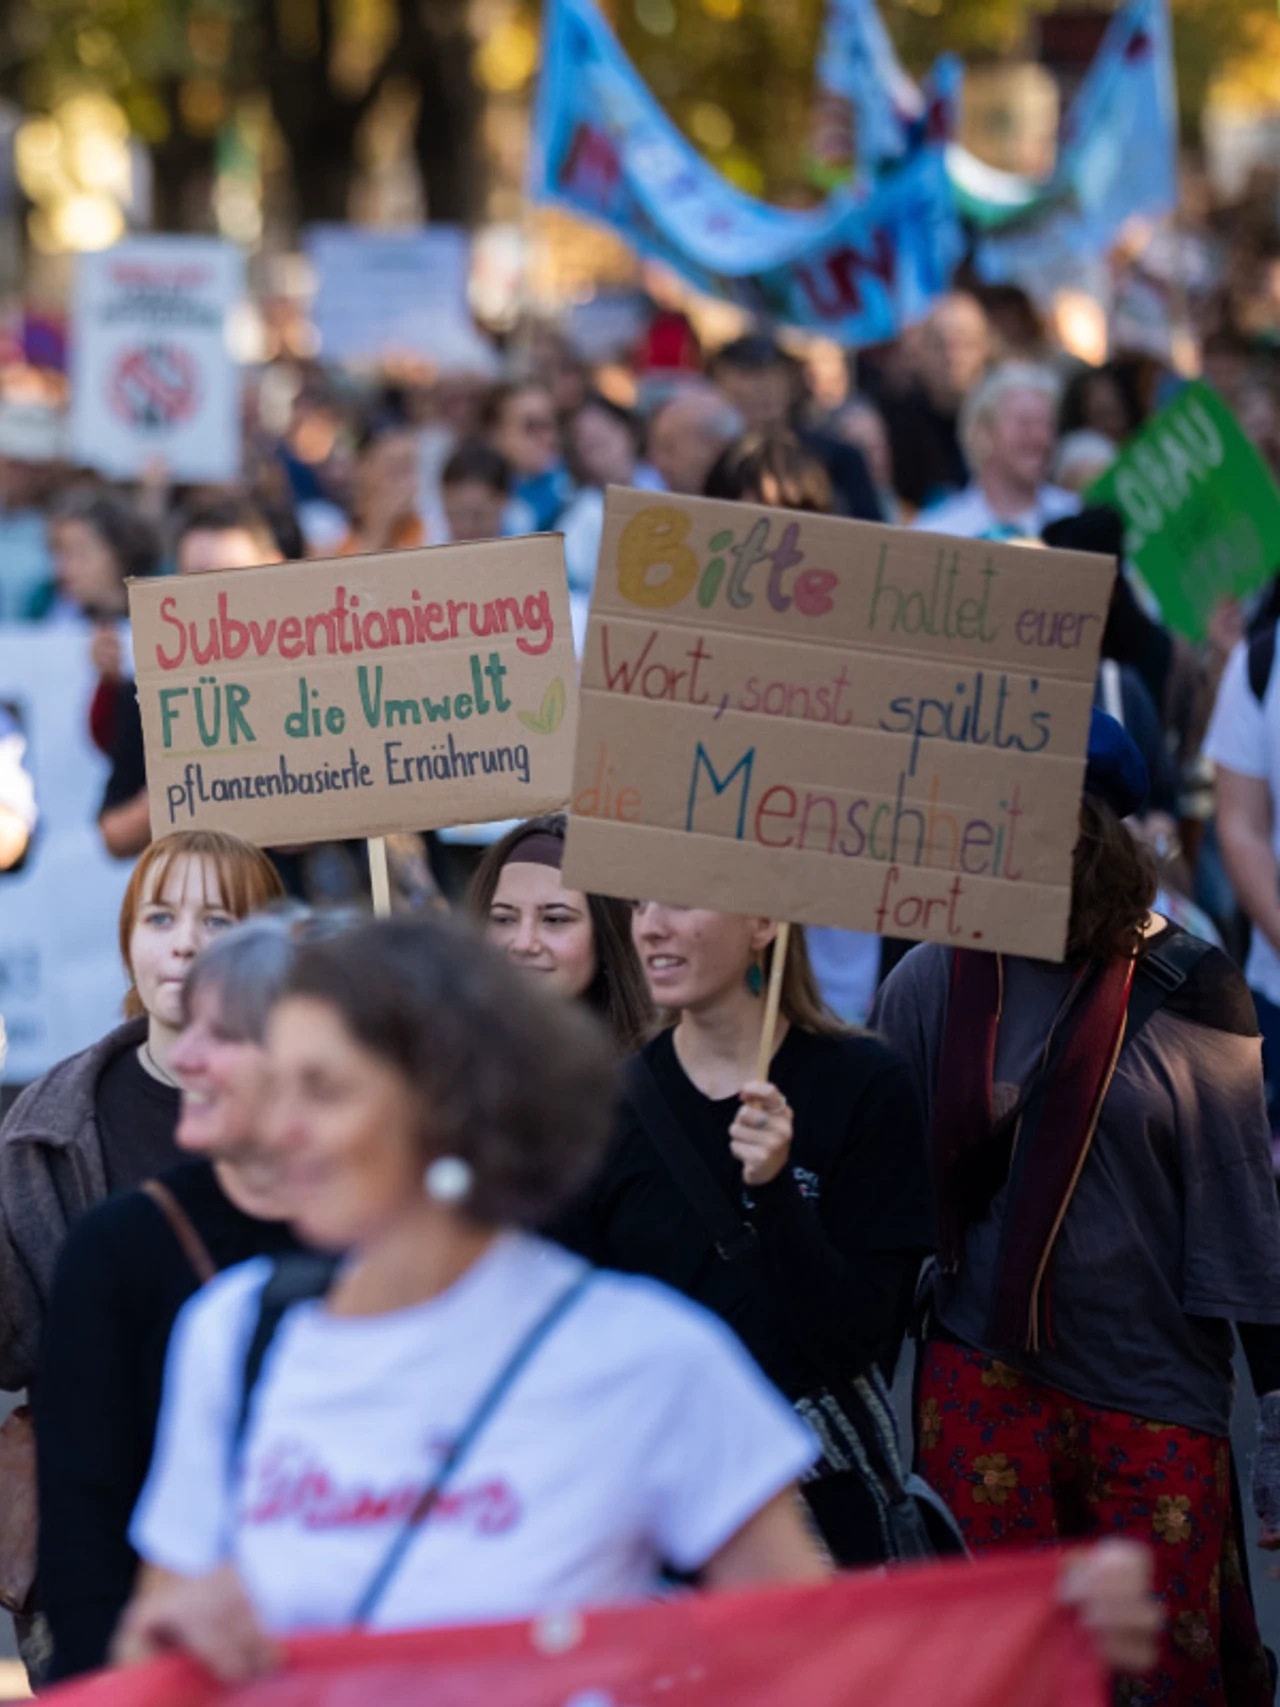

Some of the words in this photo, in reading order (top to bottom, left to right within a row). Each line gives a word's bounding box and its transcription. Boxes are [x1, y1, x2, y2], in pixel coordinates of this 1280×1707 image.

[616, 505, 839, 617] Bitte
[1014, 606, 1099, 650] euer
[155, 585, 553, 671] Subventionierung
[158, 676, 257, 749] FÜR
[284, 676, 347, 738] die
[600, 624, 730, 720] Wort,
[737, 666, 856, 726] sonst
[166, 747, 375, 824] pflanzenbasierte
[384, 732, 531, 784] Ernährung
[570, 741, 642, 822] die
[685, 740, 1023, 882] Menschheit
[873, 864, 985, 940] fort.
